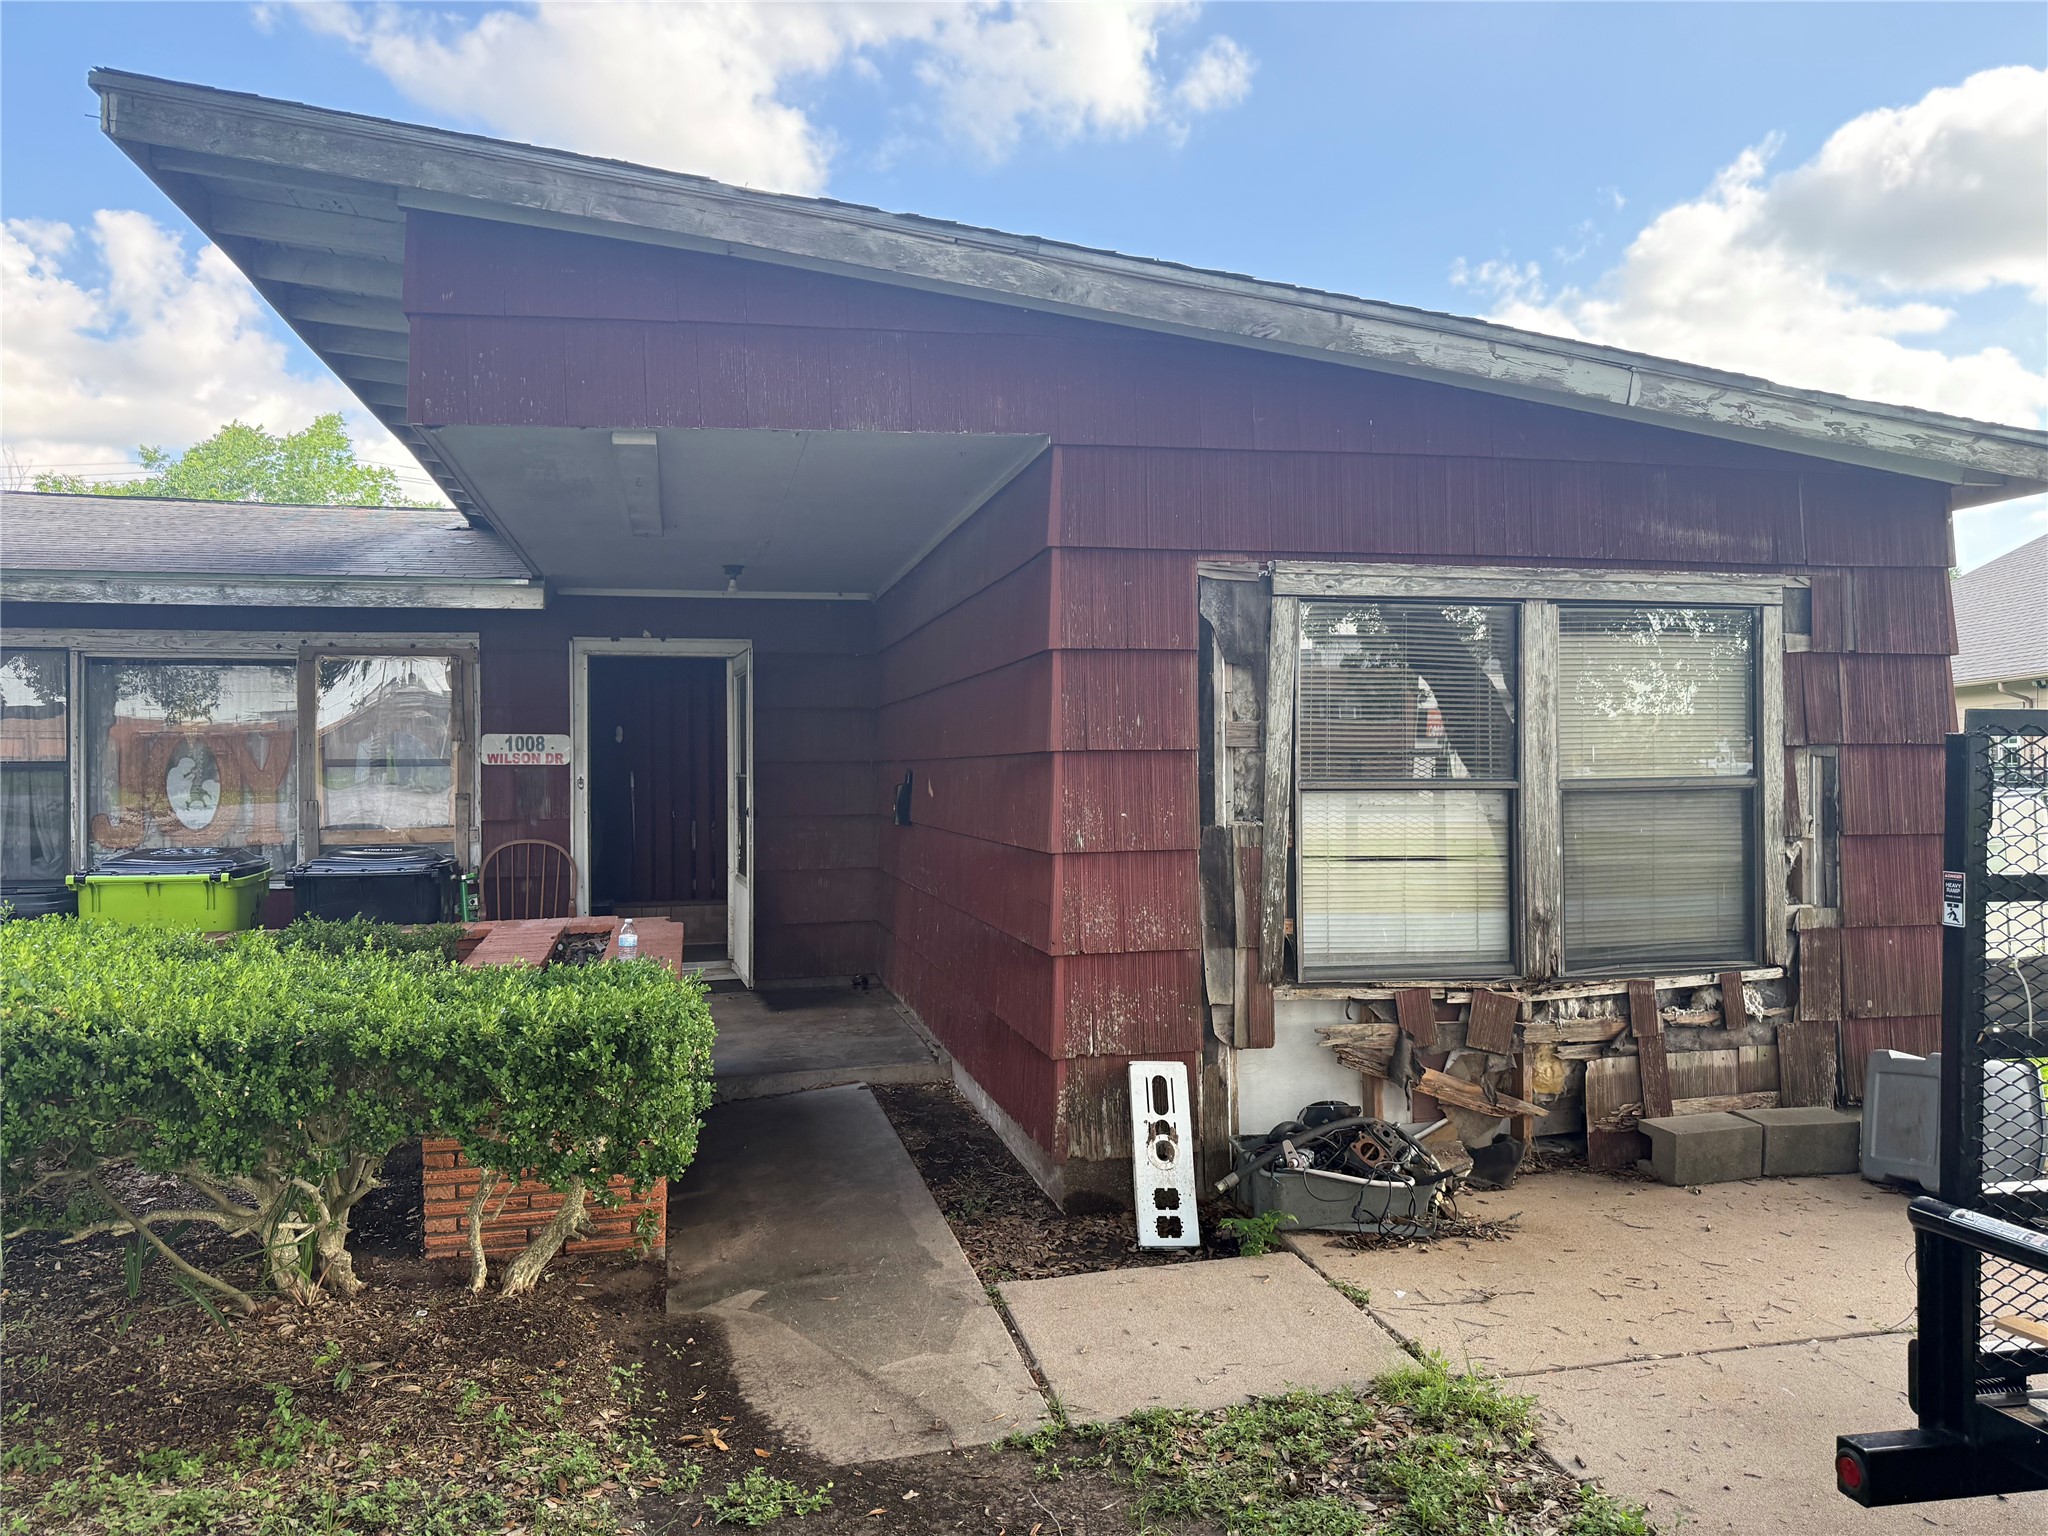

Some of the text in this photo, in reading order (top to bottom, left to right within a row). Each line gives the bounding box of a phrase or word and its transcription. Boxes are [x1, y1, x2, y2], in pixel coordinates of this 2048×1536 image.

[505, 735, 546, 753] 1008
[487, 752, 565, 764] WILSON DR
[91, 721, 294, 849] JOY
